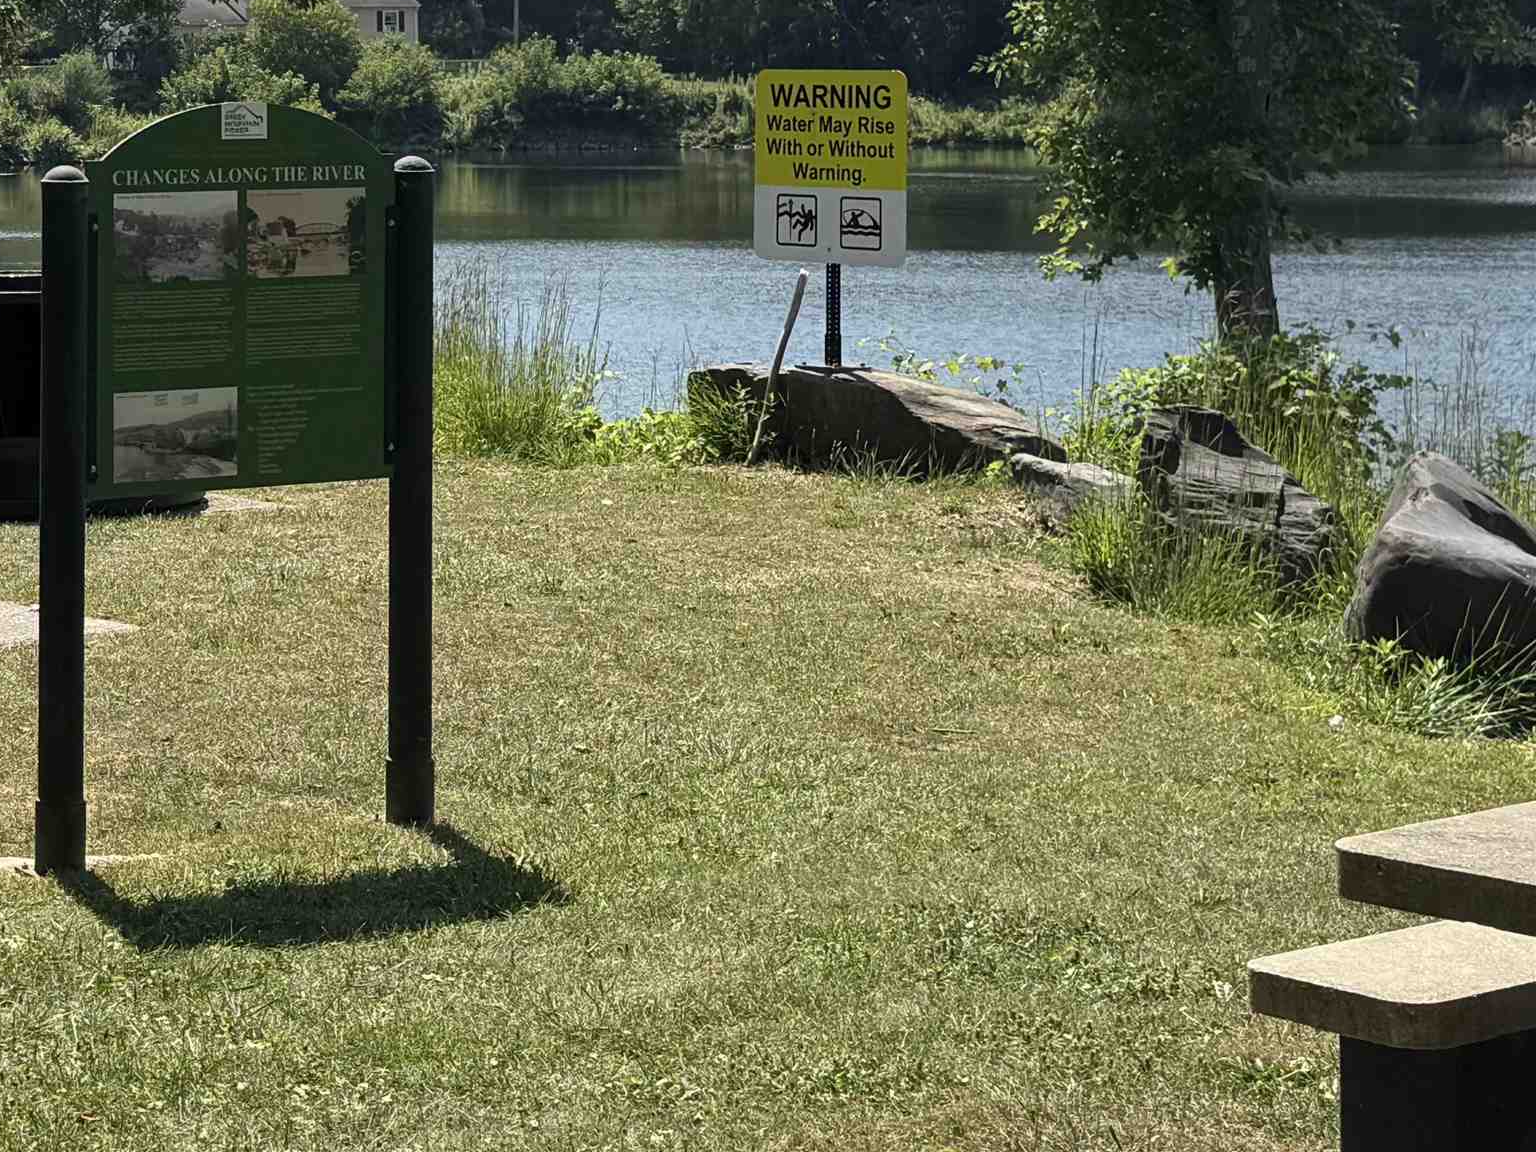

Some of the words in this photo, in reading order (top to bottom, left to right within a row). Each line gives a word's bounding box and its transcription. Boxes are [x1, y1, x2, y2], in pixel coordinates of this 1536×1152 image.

[770, 84, 892, 109] WARNING
[766, 115, 814, 132] Water
[819, 116, 852, 137] May
[858, 117, 895, 134] Rise
[766, 138, 802, 156] With
[807, 143, 824, 156] or
[828, 140, 895, 159] Without
[112, 168, 200, 186] CHANGES
[204, 166, 268, 184] ALONG
[272, 165, 308, 183] THE
[313, 164, 365, 181] RIVER
[793, 163, 867, 186] Warning.
